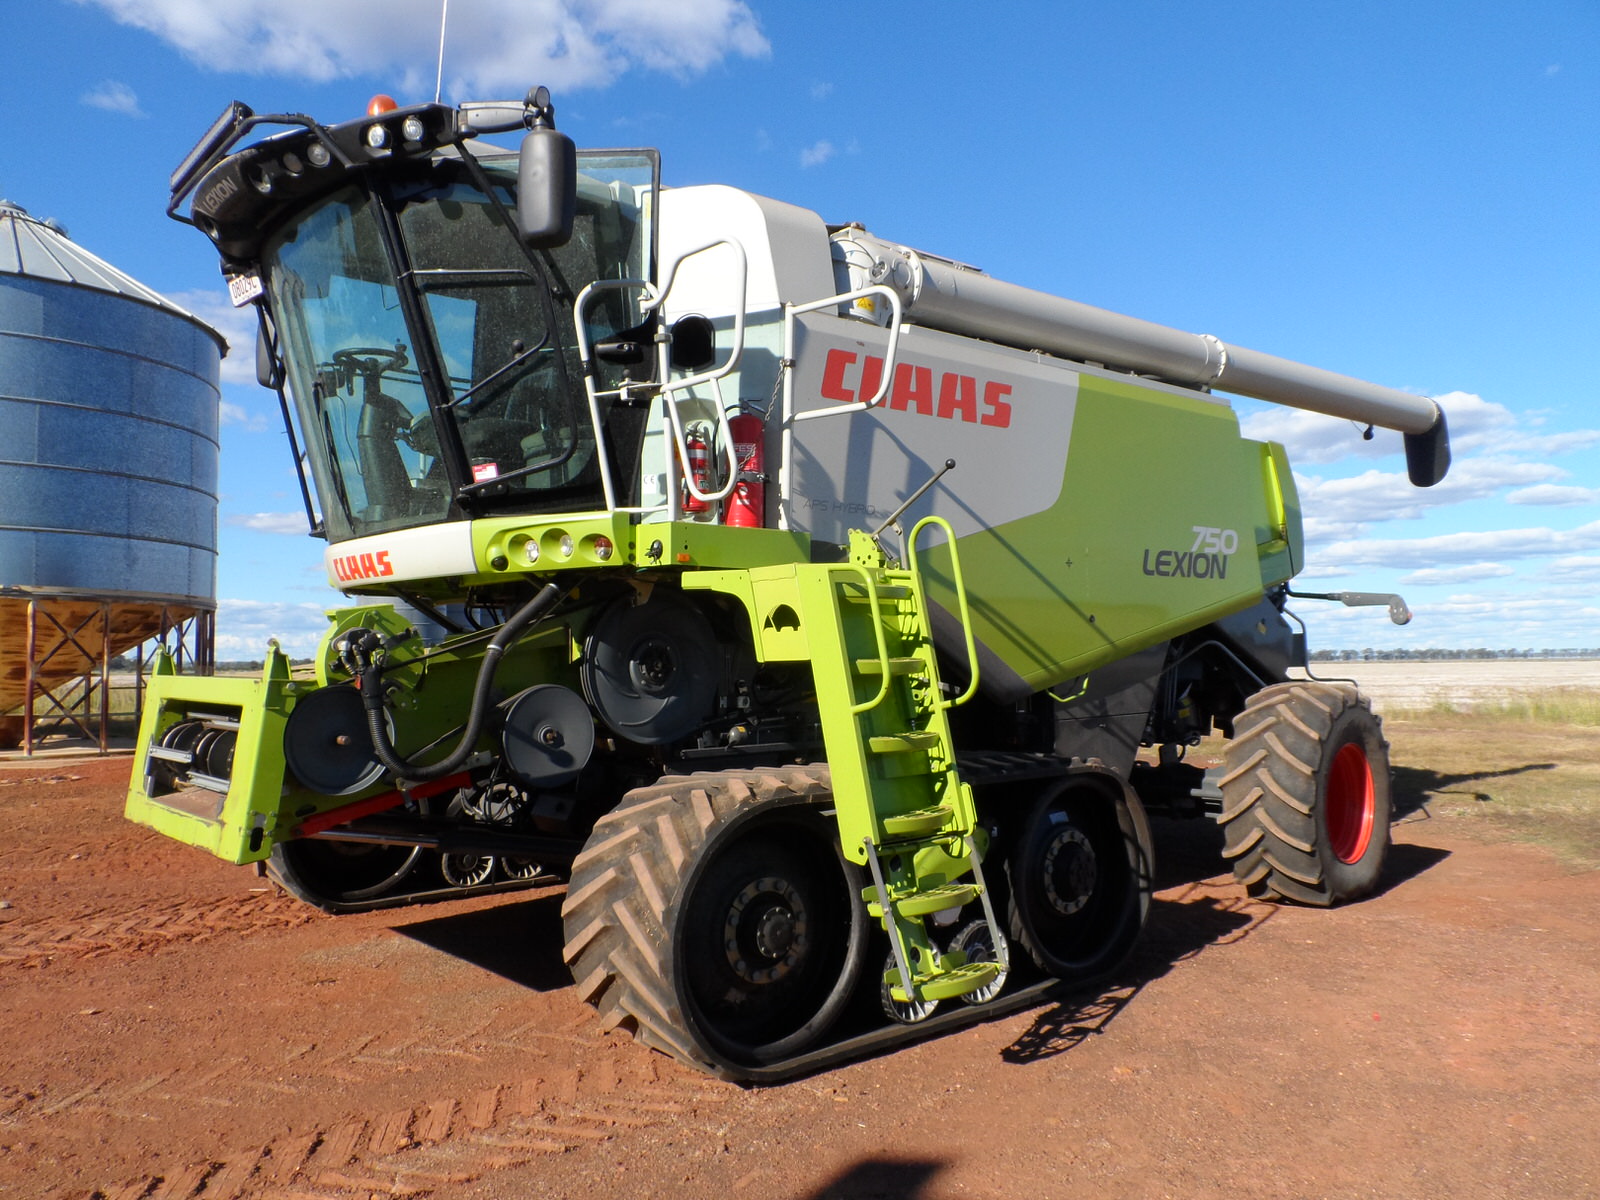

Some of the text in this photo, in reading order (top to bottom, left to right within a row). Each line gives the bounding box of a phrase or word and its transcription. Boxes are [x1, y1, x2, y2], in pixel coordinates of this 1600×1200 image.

[202, 176, 238, 213] LEXION
[821, 348, 1012, 428] CLAAS
[803, 499, 829, 512] APS
[1191, 525, 1238, 554] 750
[333, 550, 394, 581] CLAAS
[1142, 549, 1227, 579] LEXION
